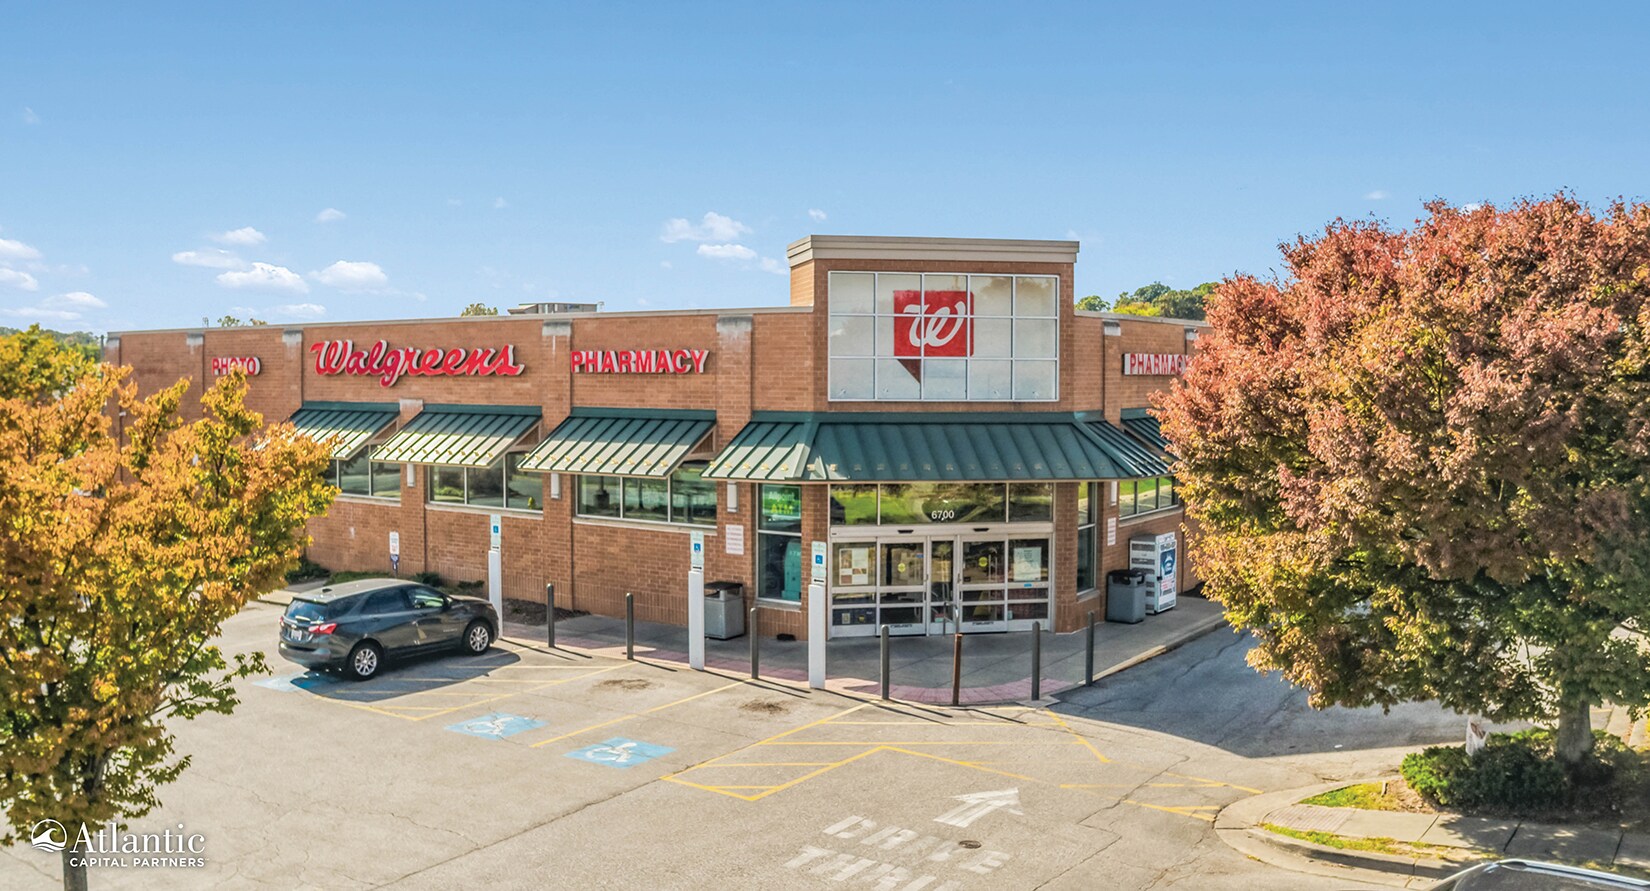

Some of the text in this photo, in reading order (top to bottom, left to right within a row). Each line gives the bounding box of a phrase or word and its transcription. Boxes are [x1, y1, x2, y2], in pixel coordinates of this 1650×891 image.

[310, 340, 525, 388] Walgreens
[571, 349, 709, 375] PHARMACY
[931, 510, 955, 520] 6700
